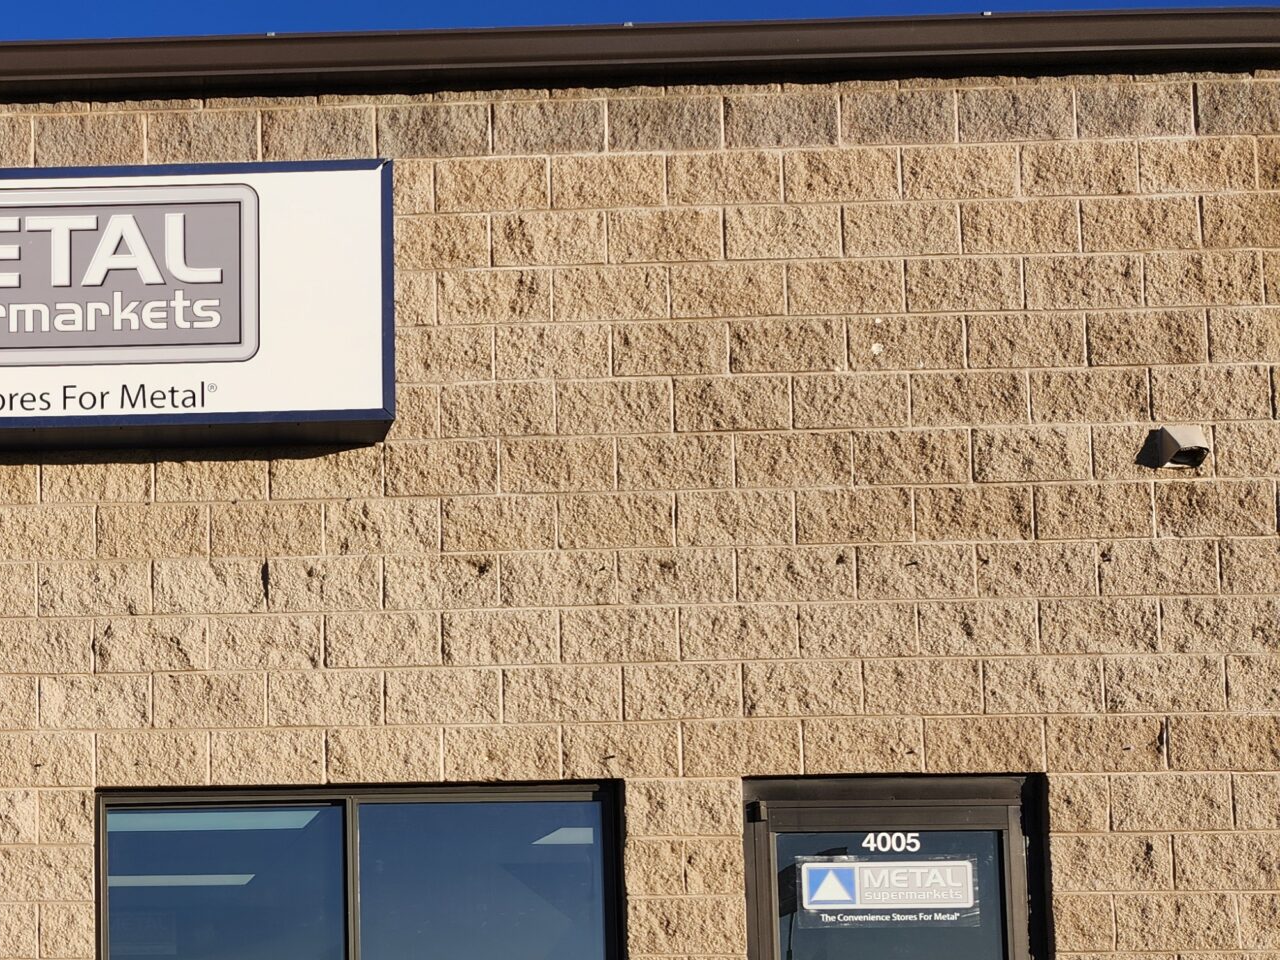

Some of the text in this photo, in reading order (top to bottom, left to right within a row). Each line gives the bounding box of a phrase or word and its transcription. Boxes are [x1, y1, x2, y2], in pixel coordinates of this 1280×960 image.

[62, 384, 110, 410] For
[862, 832, 921, 852] 4005
[863, 867, 963, 888] METAL
[864, 889, 962, 903] supermarkets
[820, 913, 837, 922] The
[837, 913, 891, 922] Convenience
[892, 912, 918, 921] Stores
[919, 912, 933, 921] For
